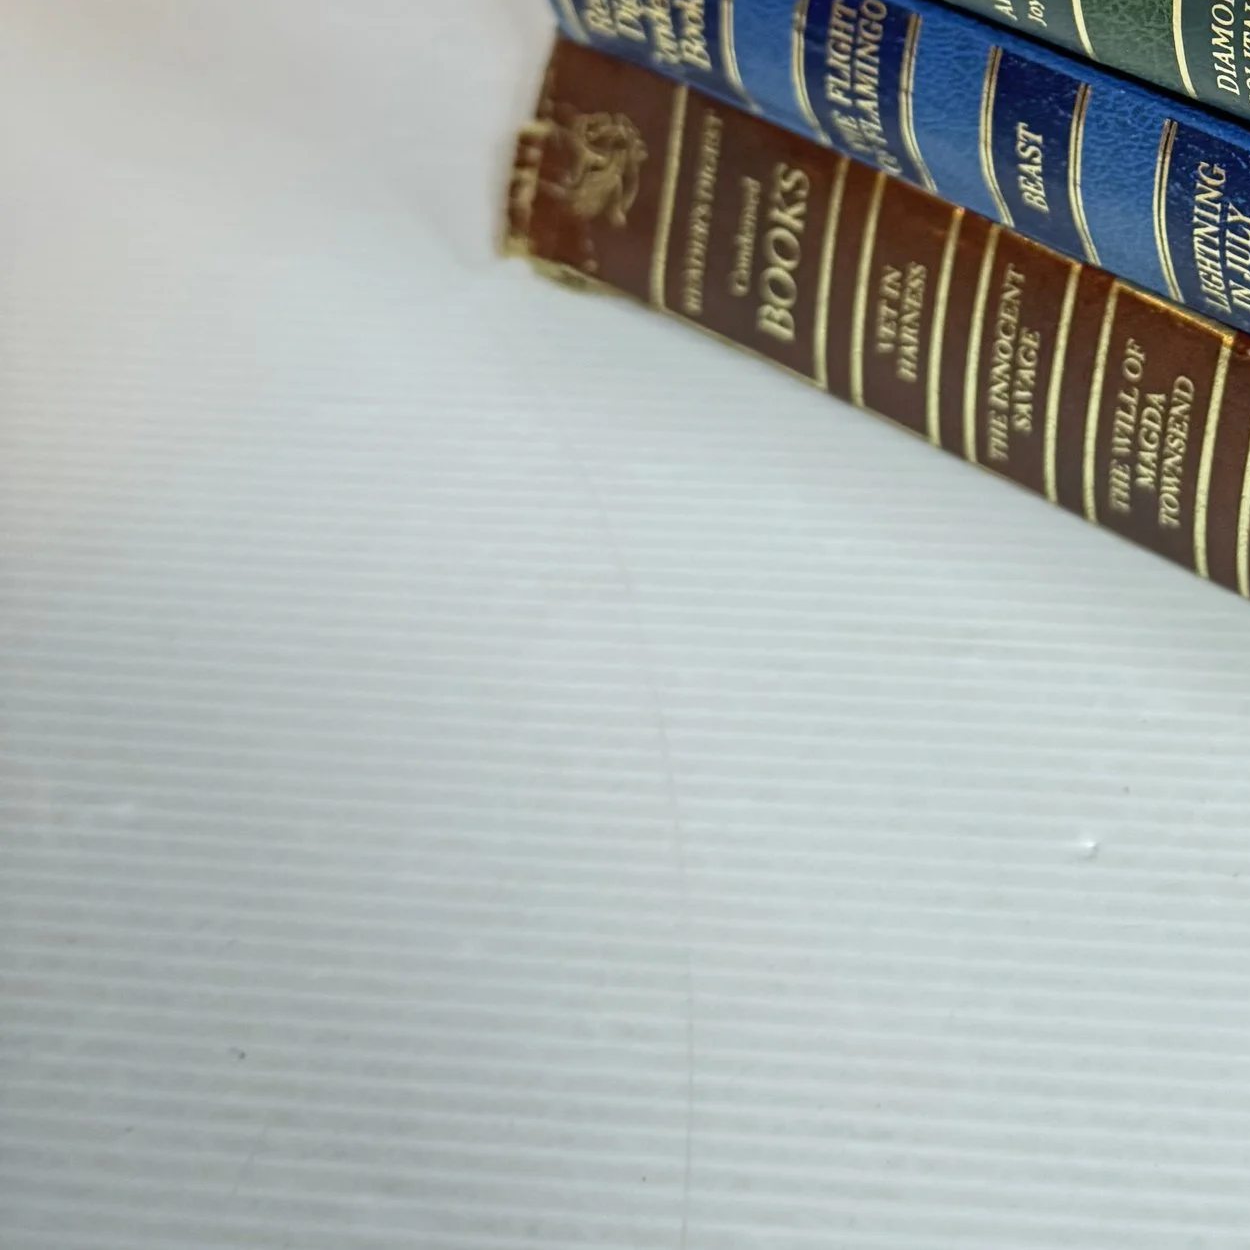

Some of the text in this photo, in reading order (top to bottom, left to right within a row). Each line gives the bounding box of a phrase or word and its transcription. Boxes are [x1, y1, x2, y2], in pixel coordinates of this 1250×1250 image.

[1016, 122, 1049, 214] BEAST
[1193, 161, 1232, 315] LIGHTNING
[756, 161, 810, 343] BOOKS
[896, 261, 927, 383] HARNESS
[988, 263, 1025, 462] THE INNOCENT
[1011, 326, 1041, 435] SAVAGE
[1109, 337, 1146, 515] THE WILL OF
[1135, 393, 1167, 491] MAGDA
[1158, 375, 1195, 529] TOWNSEND
